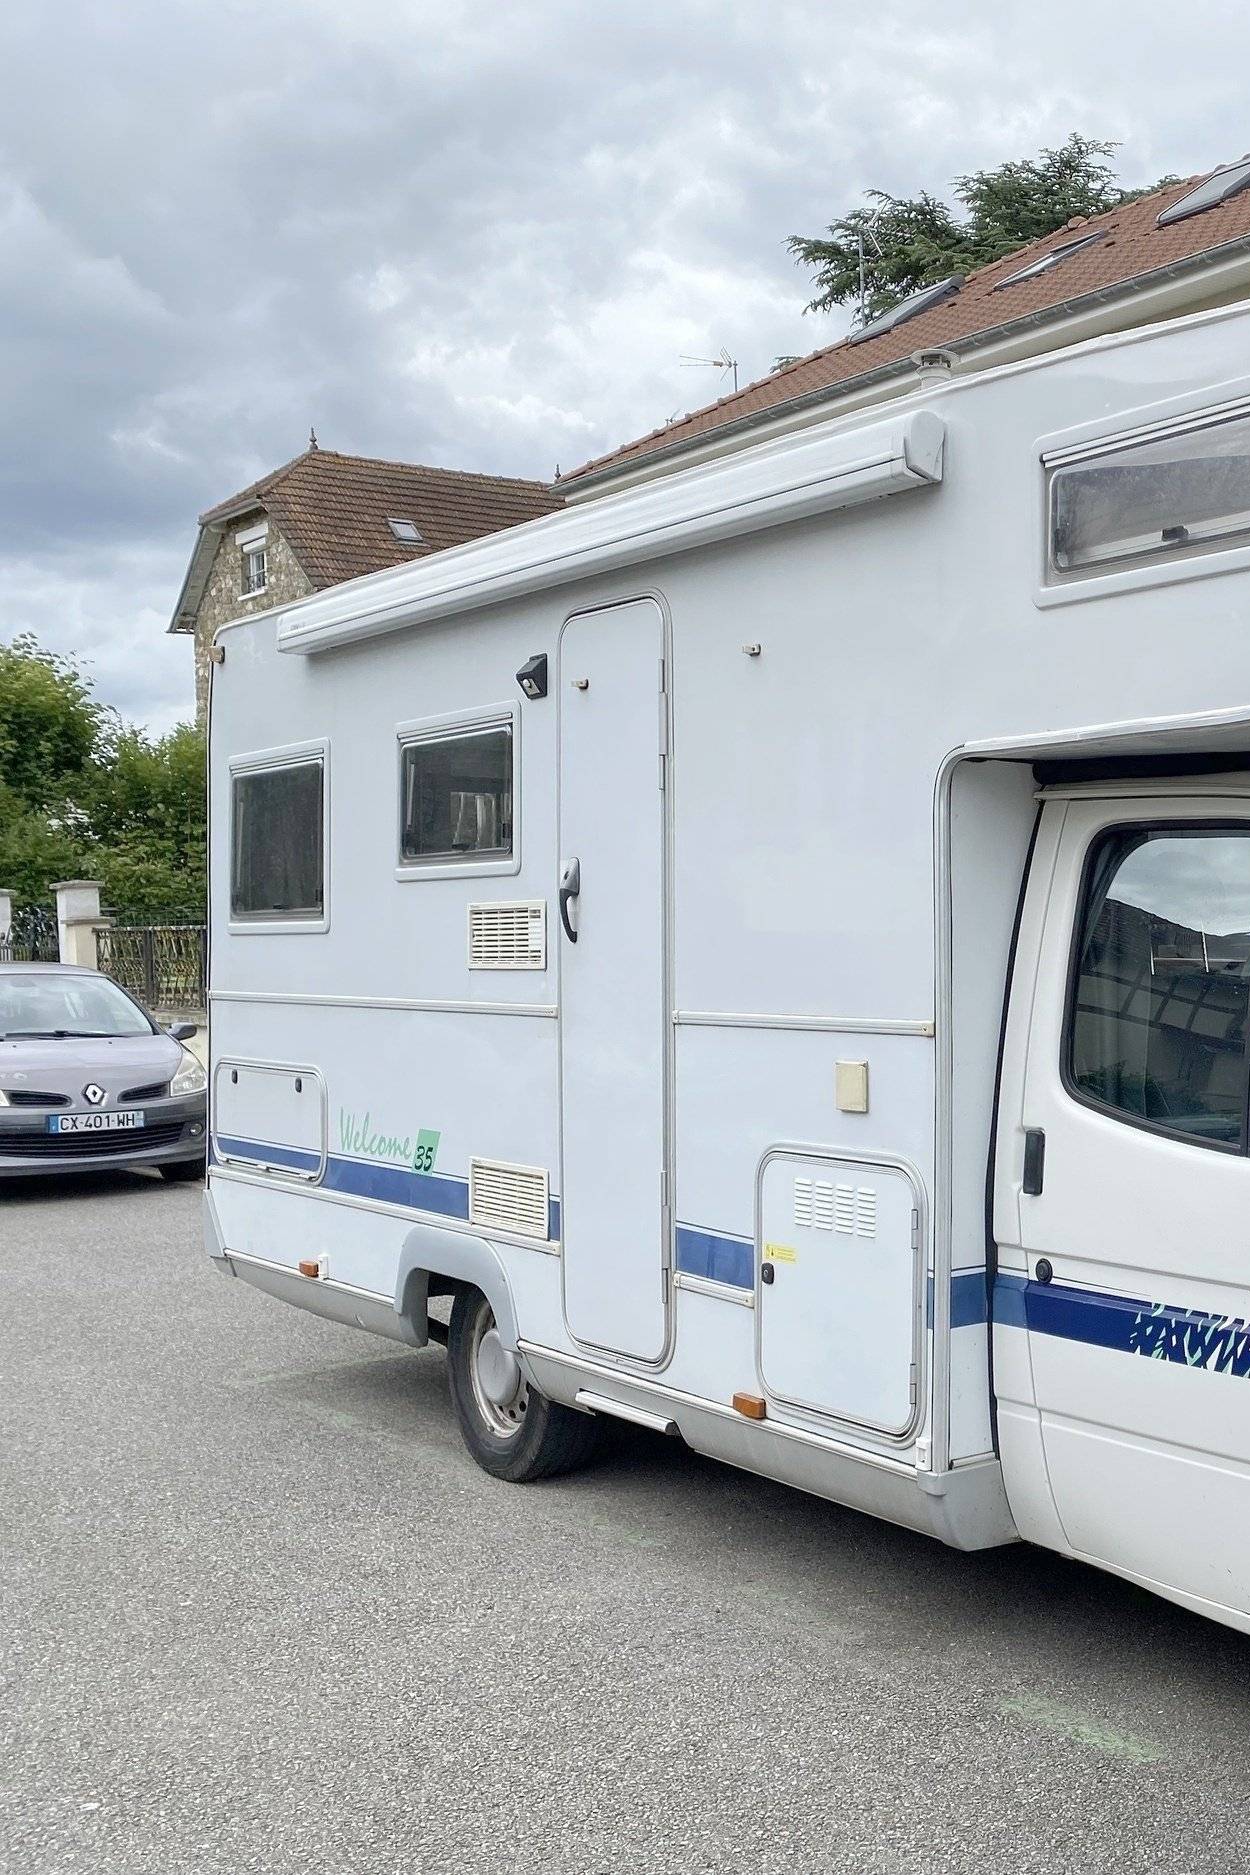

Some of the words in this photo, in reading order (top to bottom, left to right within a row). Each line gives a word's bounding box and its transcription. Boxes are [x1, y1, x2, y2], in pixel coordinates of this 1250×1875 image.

[60, 1113, 135, 1131] CX-401-WH
[339, 1106, 412, 1160] Welcome
[414, 1145, 434, 1172] 35
